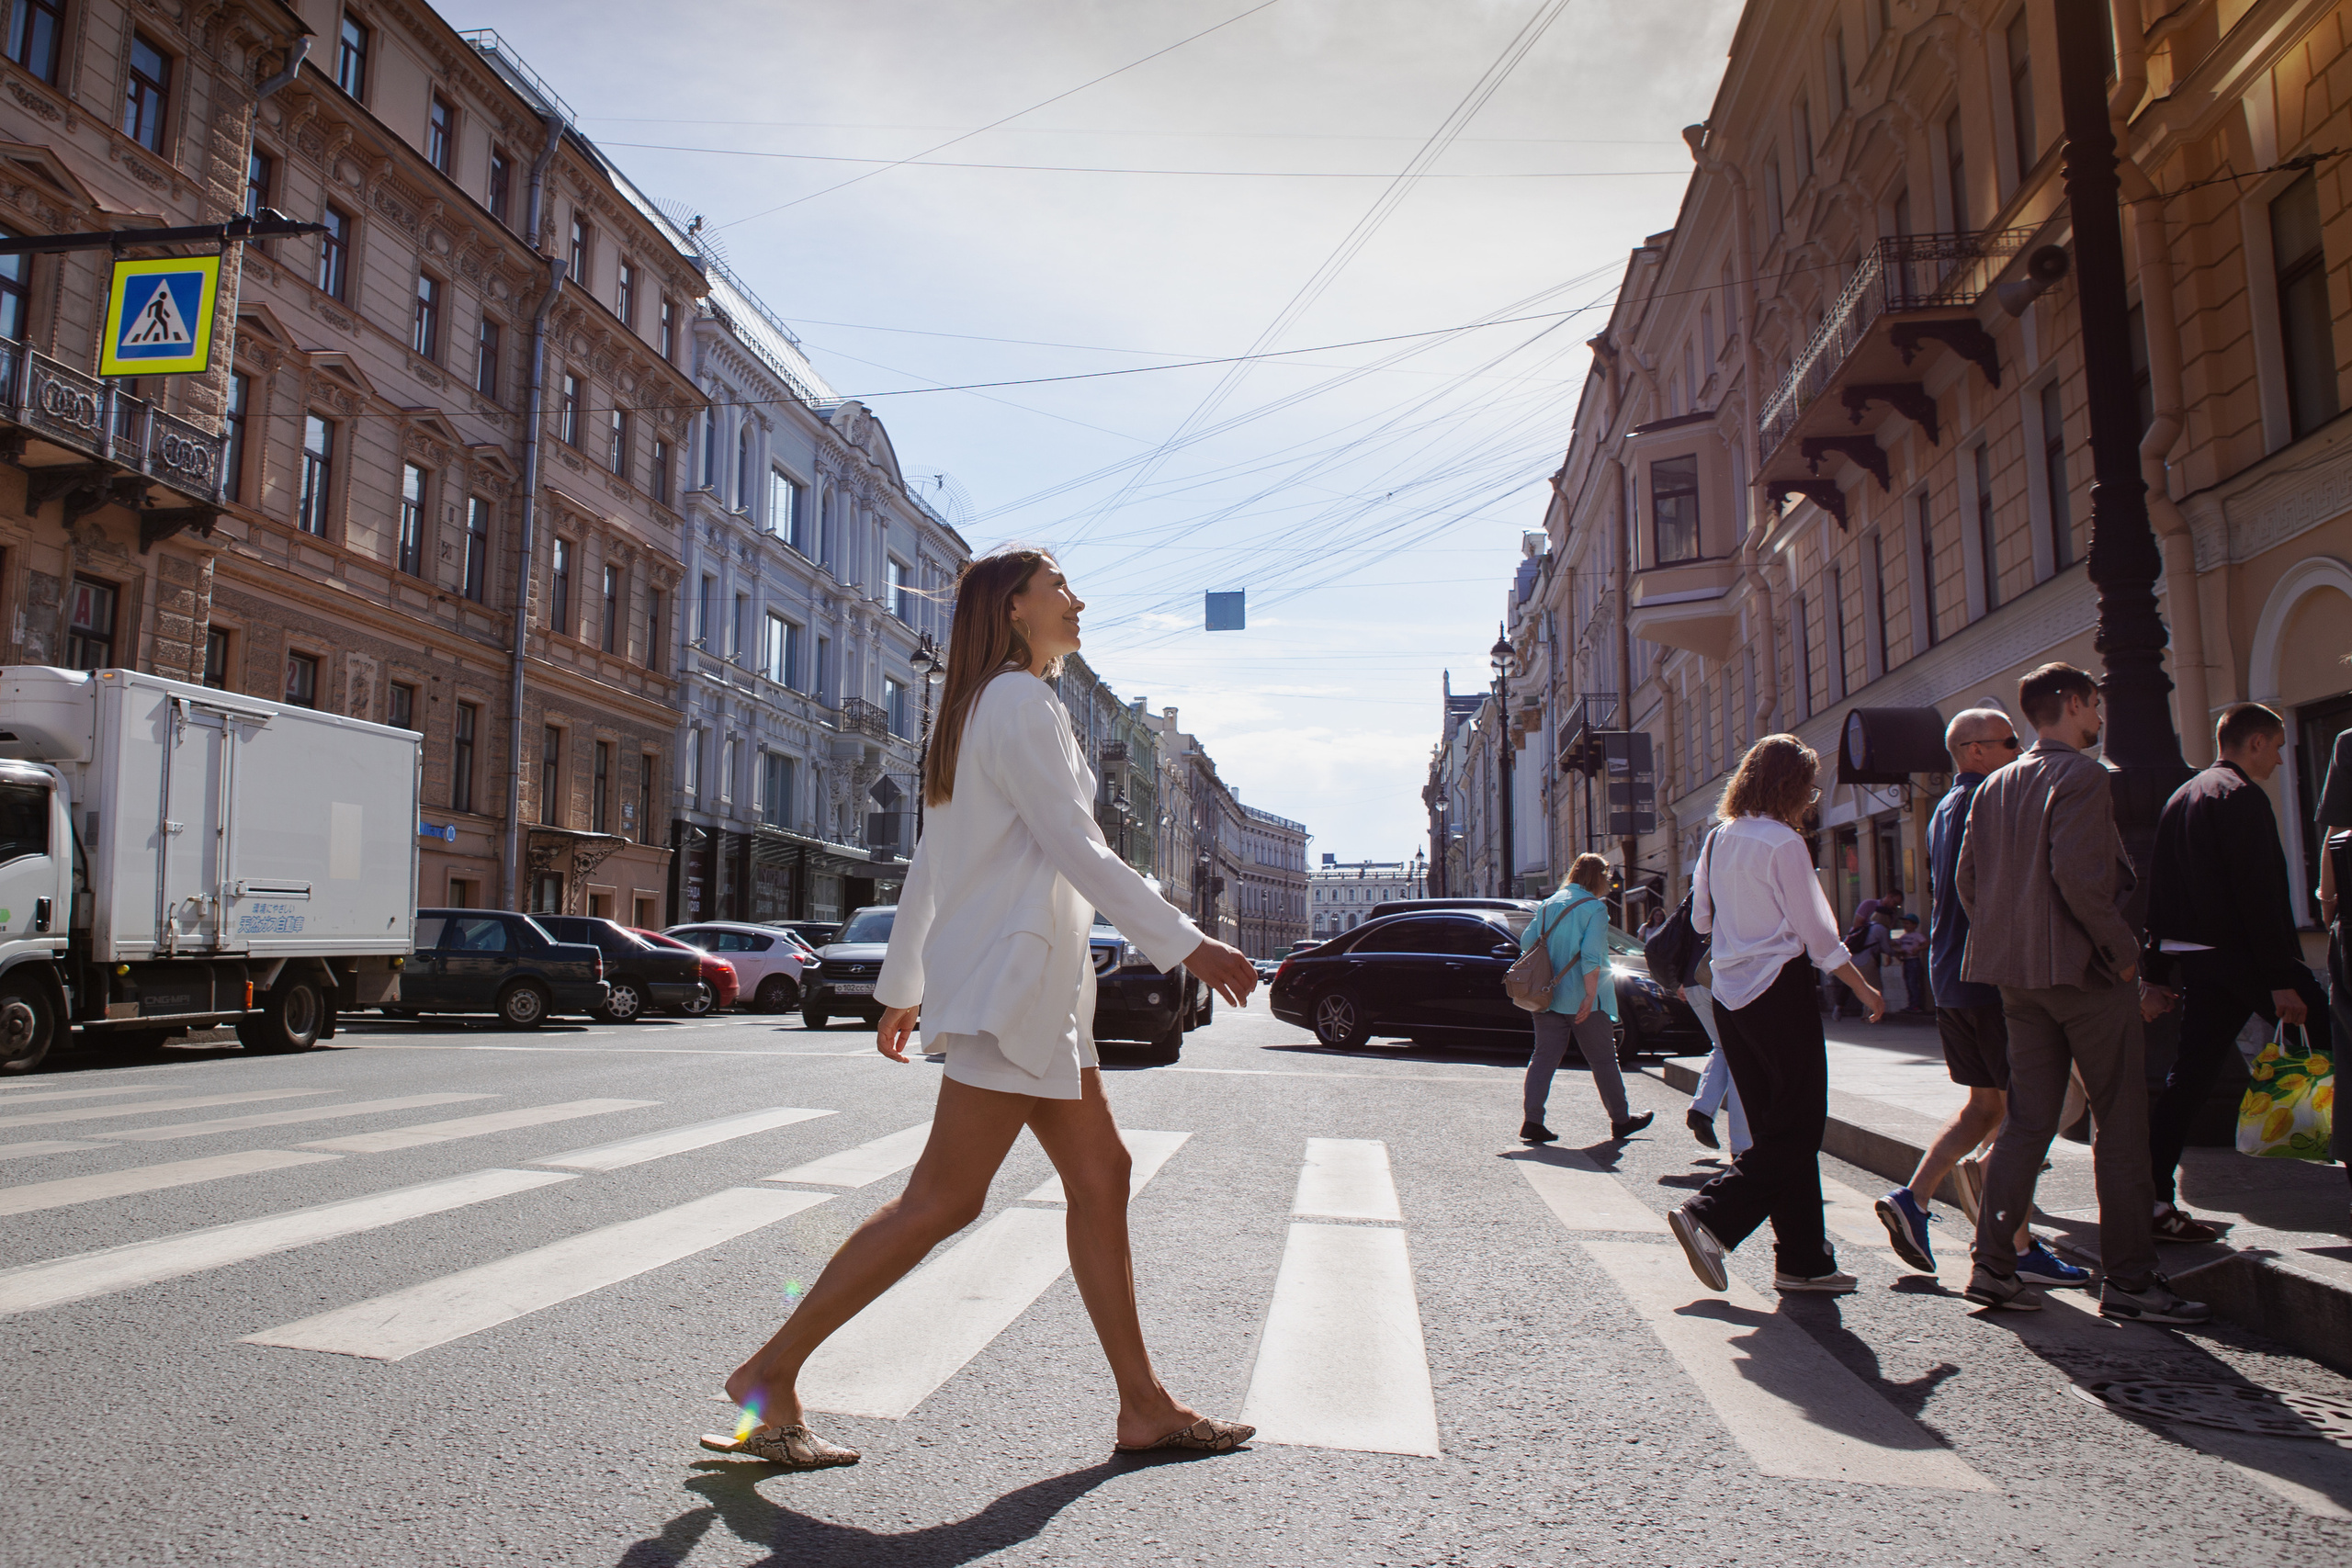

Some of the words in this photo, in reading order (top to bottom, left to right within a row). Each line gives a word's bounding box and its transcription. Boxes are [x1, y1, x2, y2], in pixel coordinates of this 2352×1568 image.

[74, 587, 90, 626] А
[286, 660, 297, 692] 2
[237, 915, 305, 933] 天然ガス自動車
[2161, 1217, 2186, 1234] N
